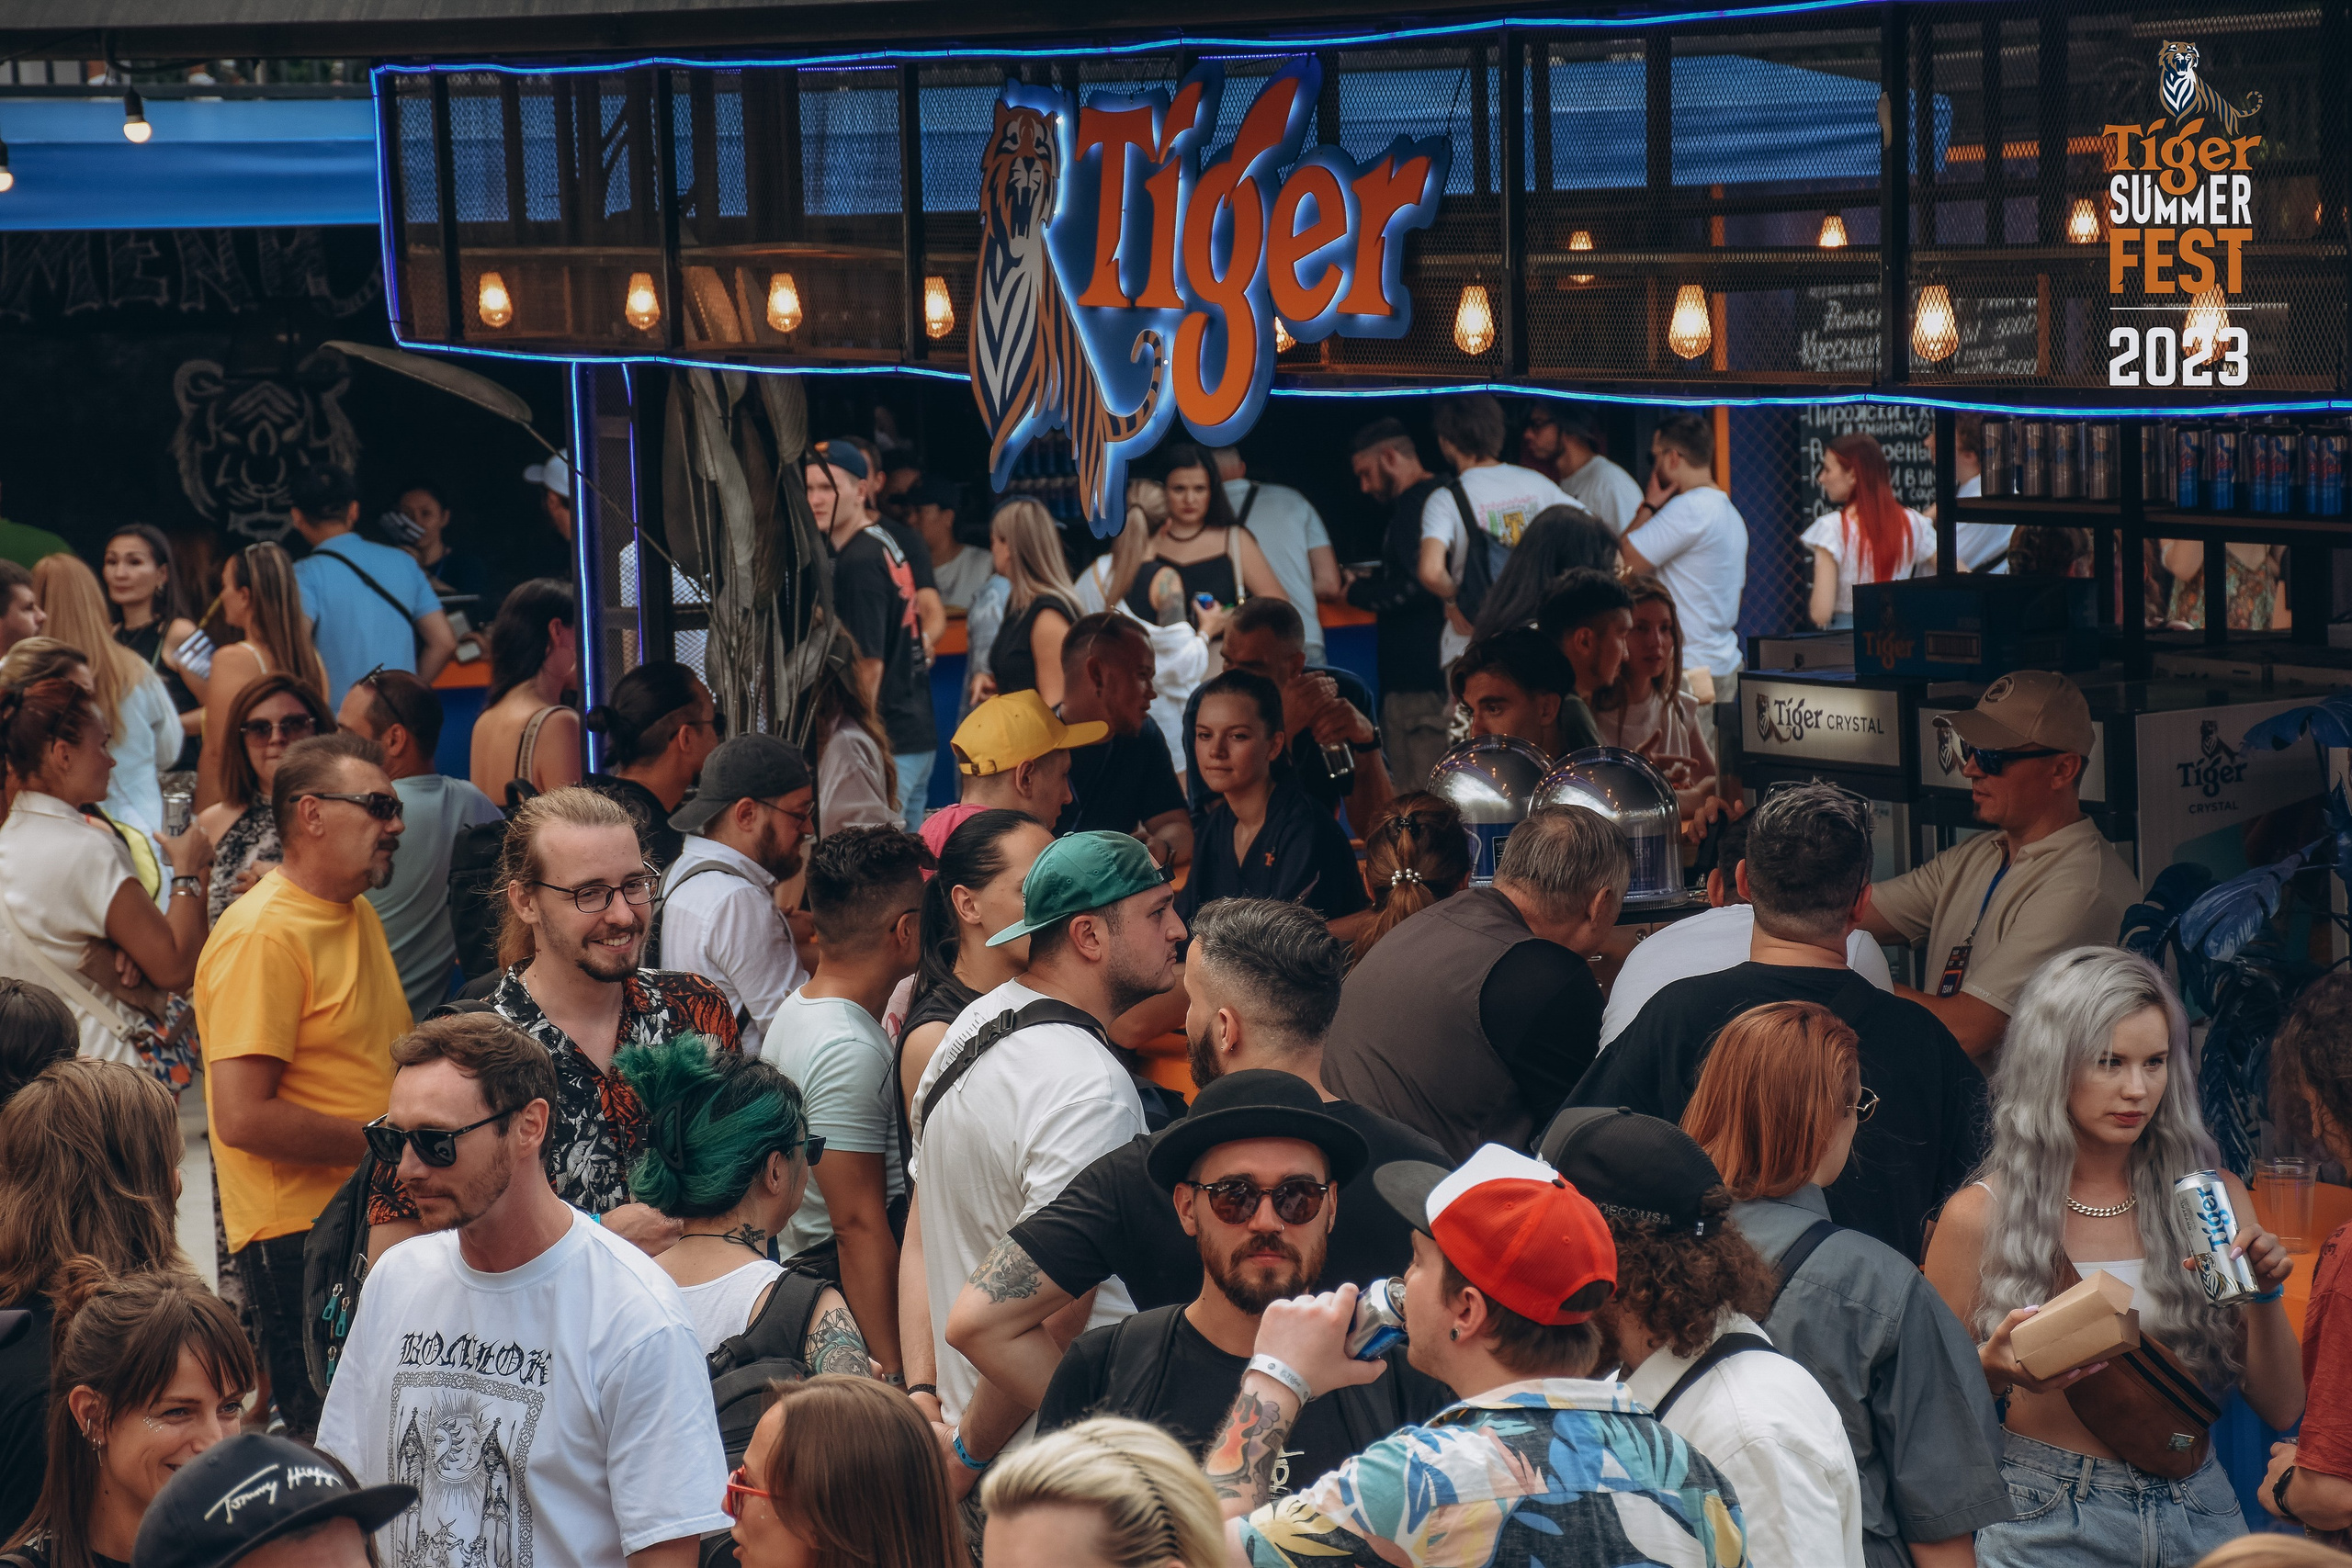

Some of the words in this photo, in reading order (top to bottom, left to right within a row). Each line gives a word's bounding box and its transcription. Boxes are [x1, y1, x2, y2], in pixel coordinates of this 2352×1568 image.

[1075, 77, 1431, 426] Tiger
[1861, 629, 1916, 671] Tiger
[1774, 696, 1824, 741] Tiger
[1826, 713, 1884, 735] CRYSTAL
[2177, 754, 2249, 798] Tiger
[2188, 801, 2239, 815] CRYSTAL
[1596, 1201, 1672, 1226] OECOUSA
[2197, 1186, 2231, 1253] Tiger
